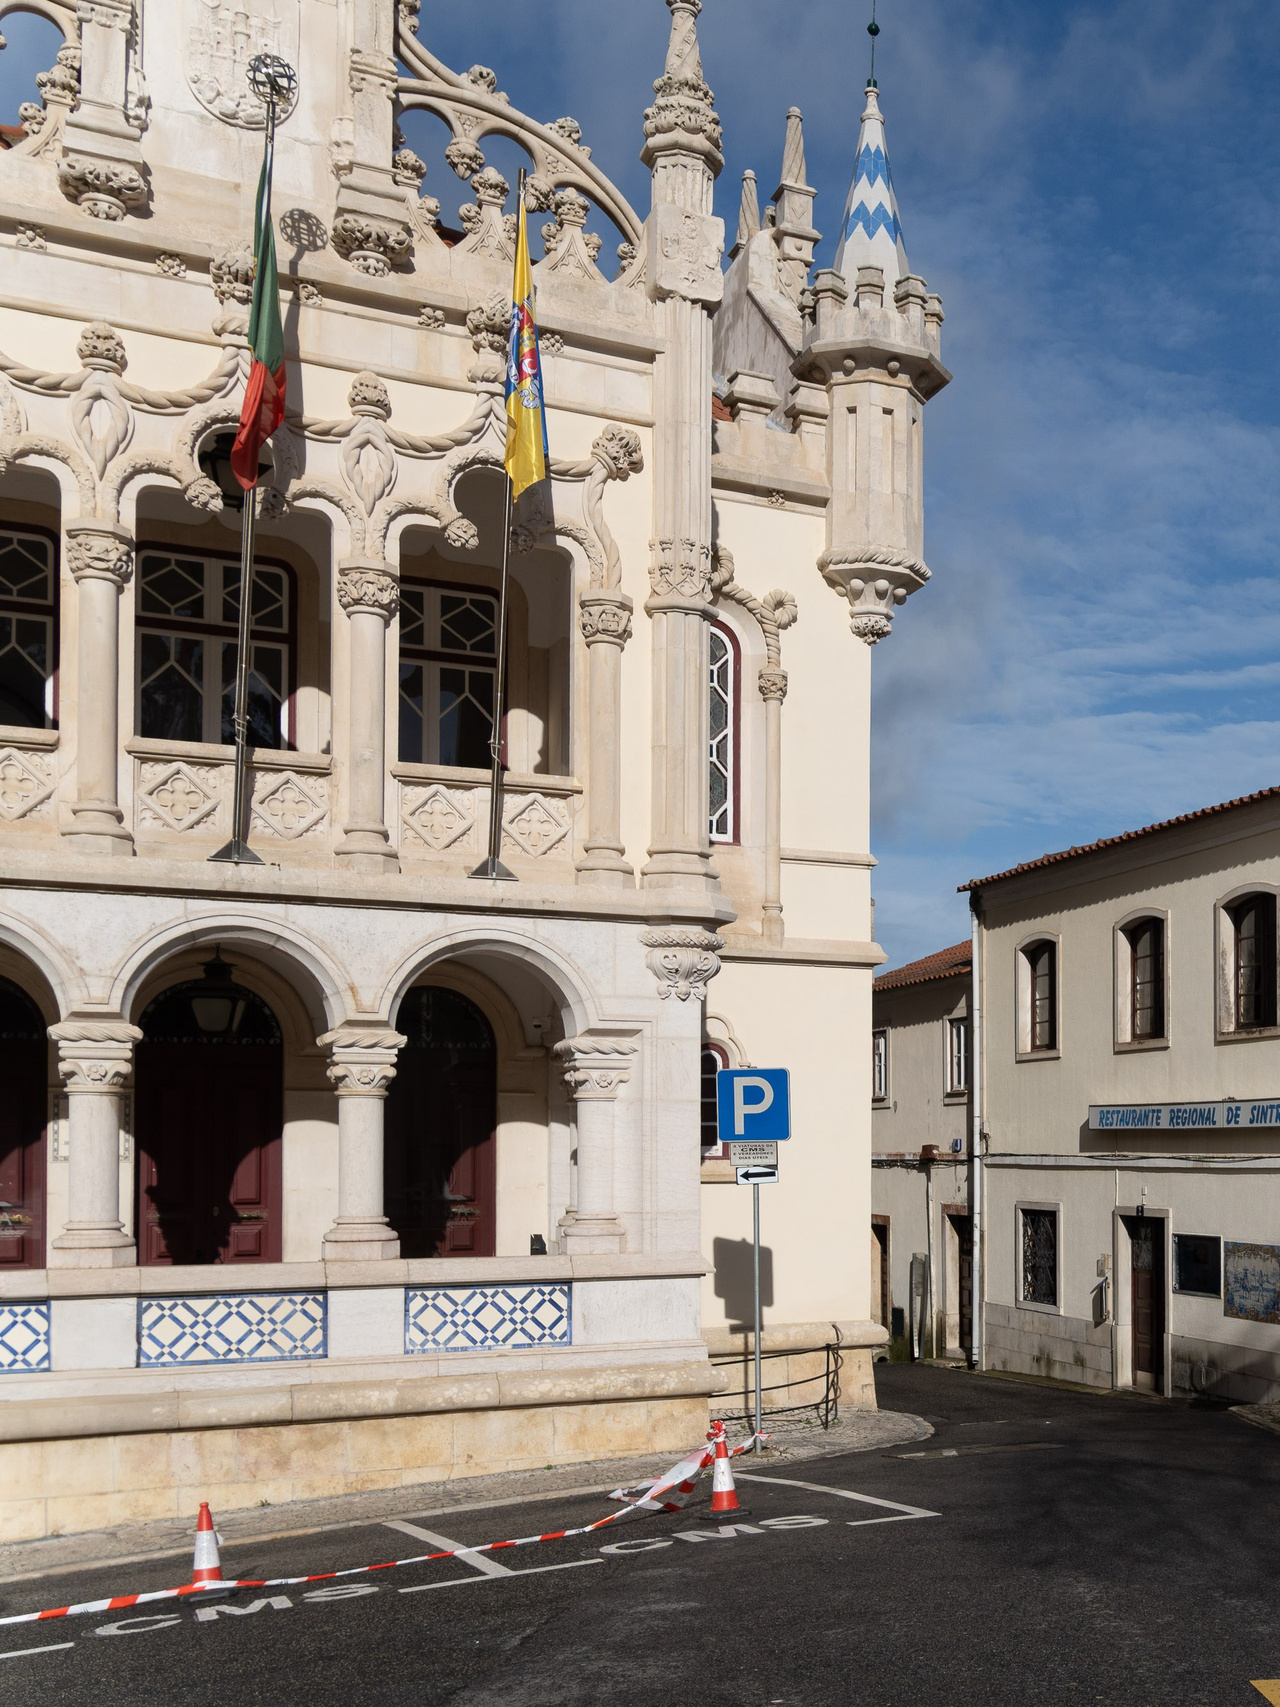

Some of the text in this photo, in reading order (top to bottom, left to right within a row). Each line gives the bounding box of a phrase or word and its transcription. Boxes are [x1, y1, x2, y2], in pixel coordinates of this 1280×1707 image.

[733, 1076, 774, 1135] P
[1098, 1108, 1162, 1128] RESTAURANTE
[1168, 1106, 1217, 1128] REGIONAL
[1225, 1105, 1242, 1125] DE
[597, 1514, 830, 1555] CMS
[86, 1583, 382, 1637] CMS
